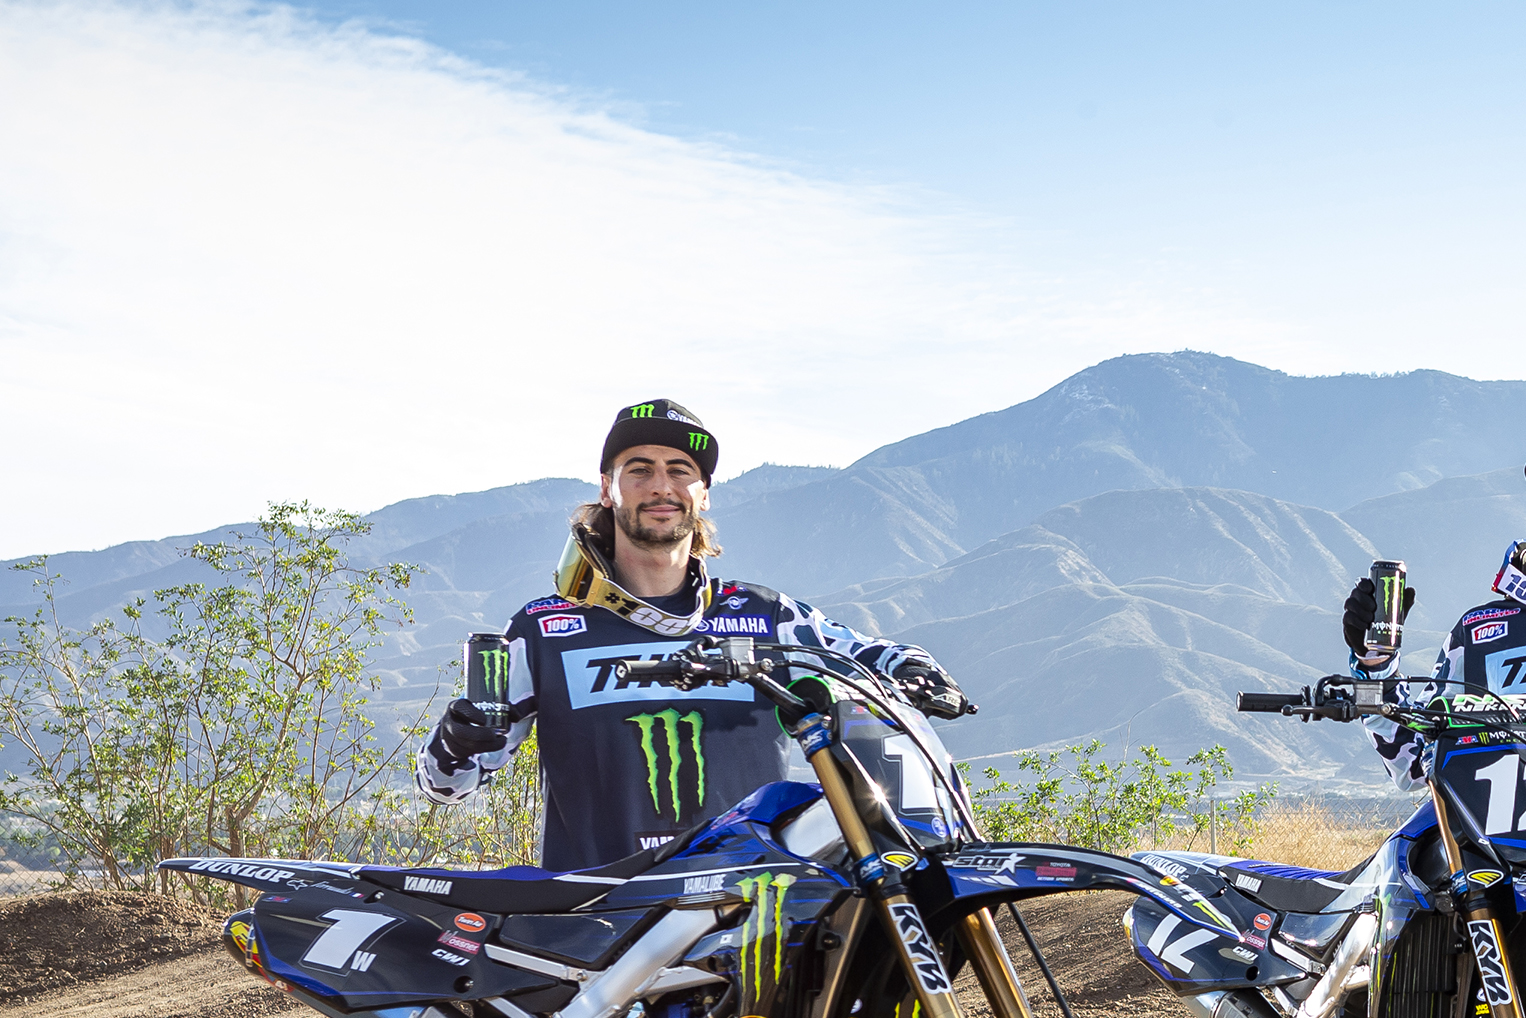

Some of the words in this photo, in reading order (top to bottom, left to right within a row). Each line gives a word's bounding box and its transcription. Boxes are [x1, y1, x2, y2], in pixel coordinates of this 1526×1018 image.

[545, 618, 580, 633] 100%
[710, 616, 769, 634] YAMAHA
[1474, 624, 1505, 641] 100%
[882, 733, 945, 812] 1
[187, 860, 297, 884] DUNLOP
[403, 875, 454, 895] YAMAHA
[302, 909, 398, 969] 1
[350, 950, 377, 972] W
